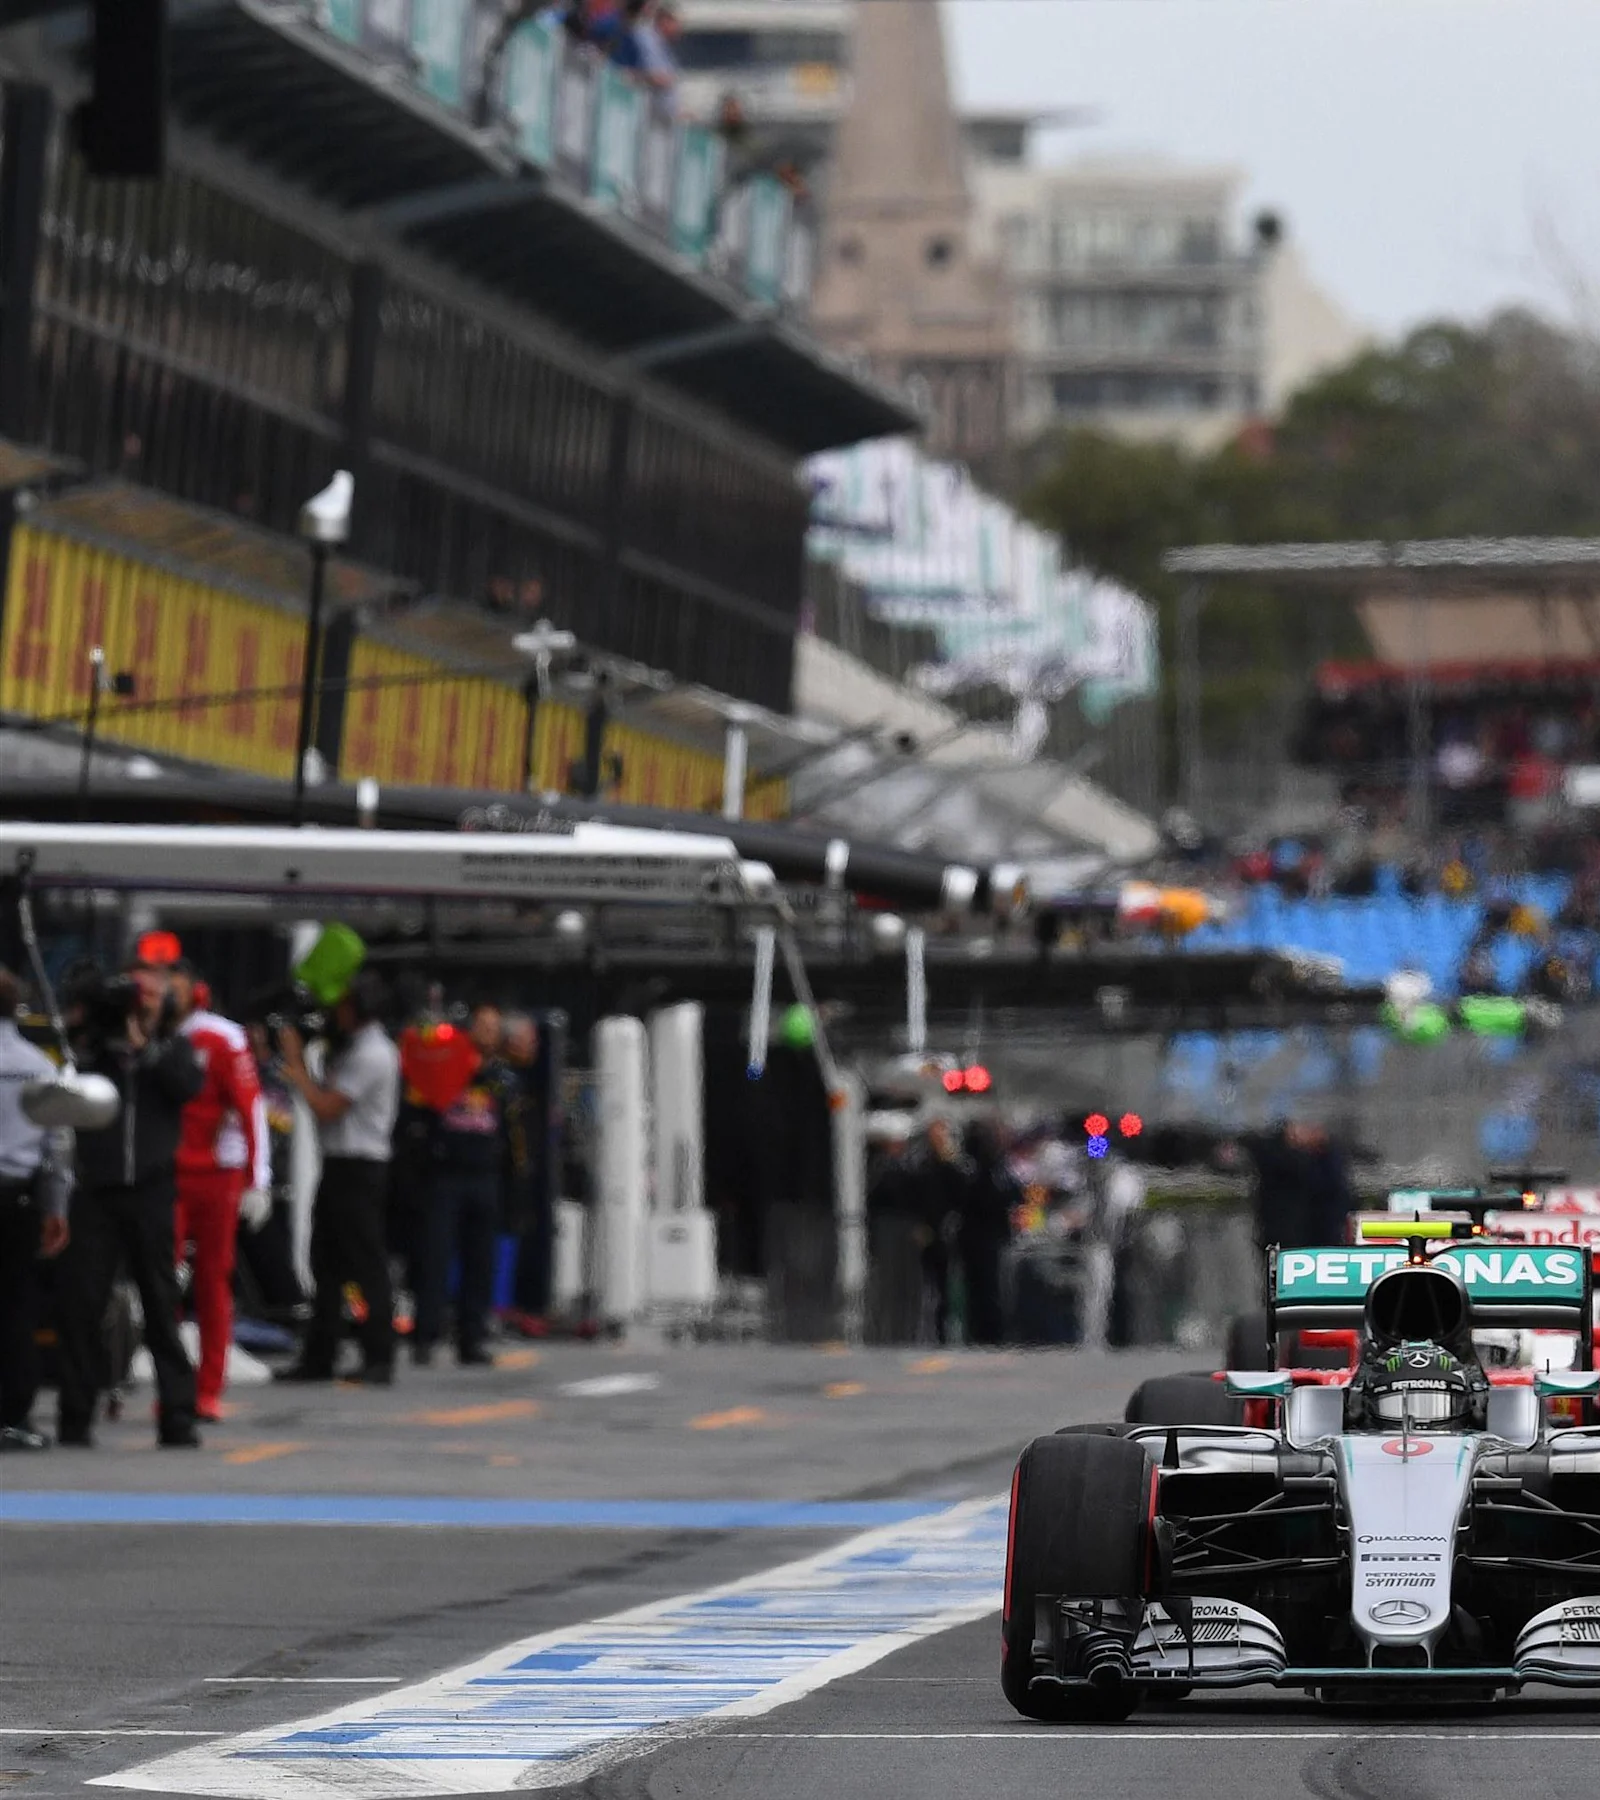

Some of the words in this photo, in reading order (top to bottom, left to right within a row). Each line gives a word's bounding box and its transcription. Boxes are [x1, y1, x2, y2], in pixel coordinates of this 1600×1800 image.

[1391, 1379, 1448, 1391] PETRONAS
[1365, 1578, 1436, 1588] SYNTIUM
[1193, 1605, 1239, 1617] RONAS
